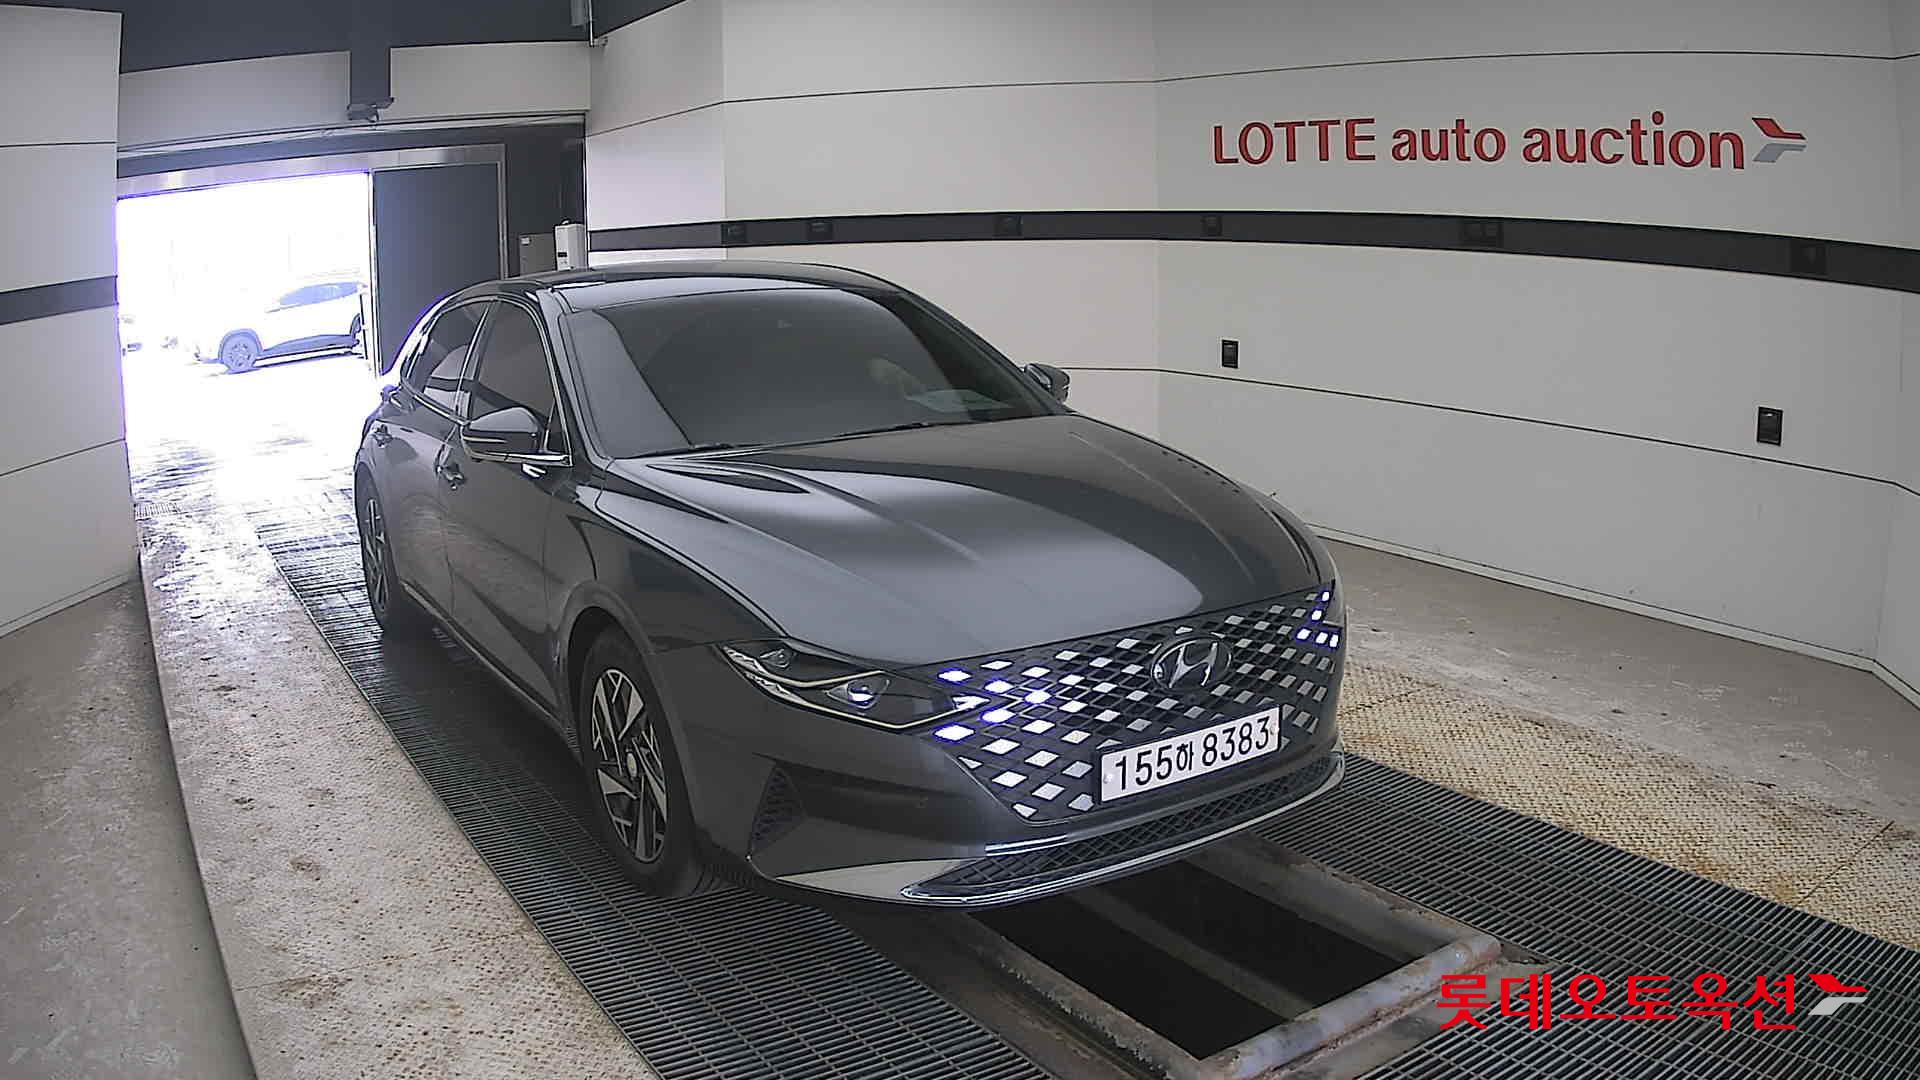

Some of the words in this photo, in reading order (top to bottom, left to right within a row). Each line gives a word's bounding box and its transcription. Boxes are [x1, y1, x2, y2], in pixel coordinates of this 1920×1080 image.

[1212, 117, 1376, 165] LOTTE
[1391, 118, 1507, 163] auto
[1522, 110, 1745, 170] auction
[1115, 740, 1195, 791] 155하
[1201, 715, 1271, 767] 8383
